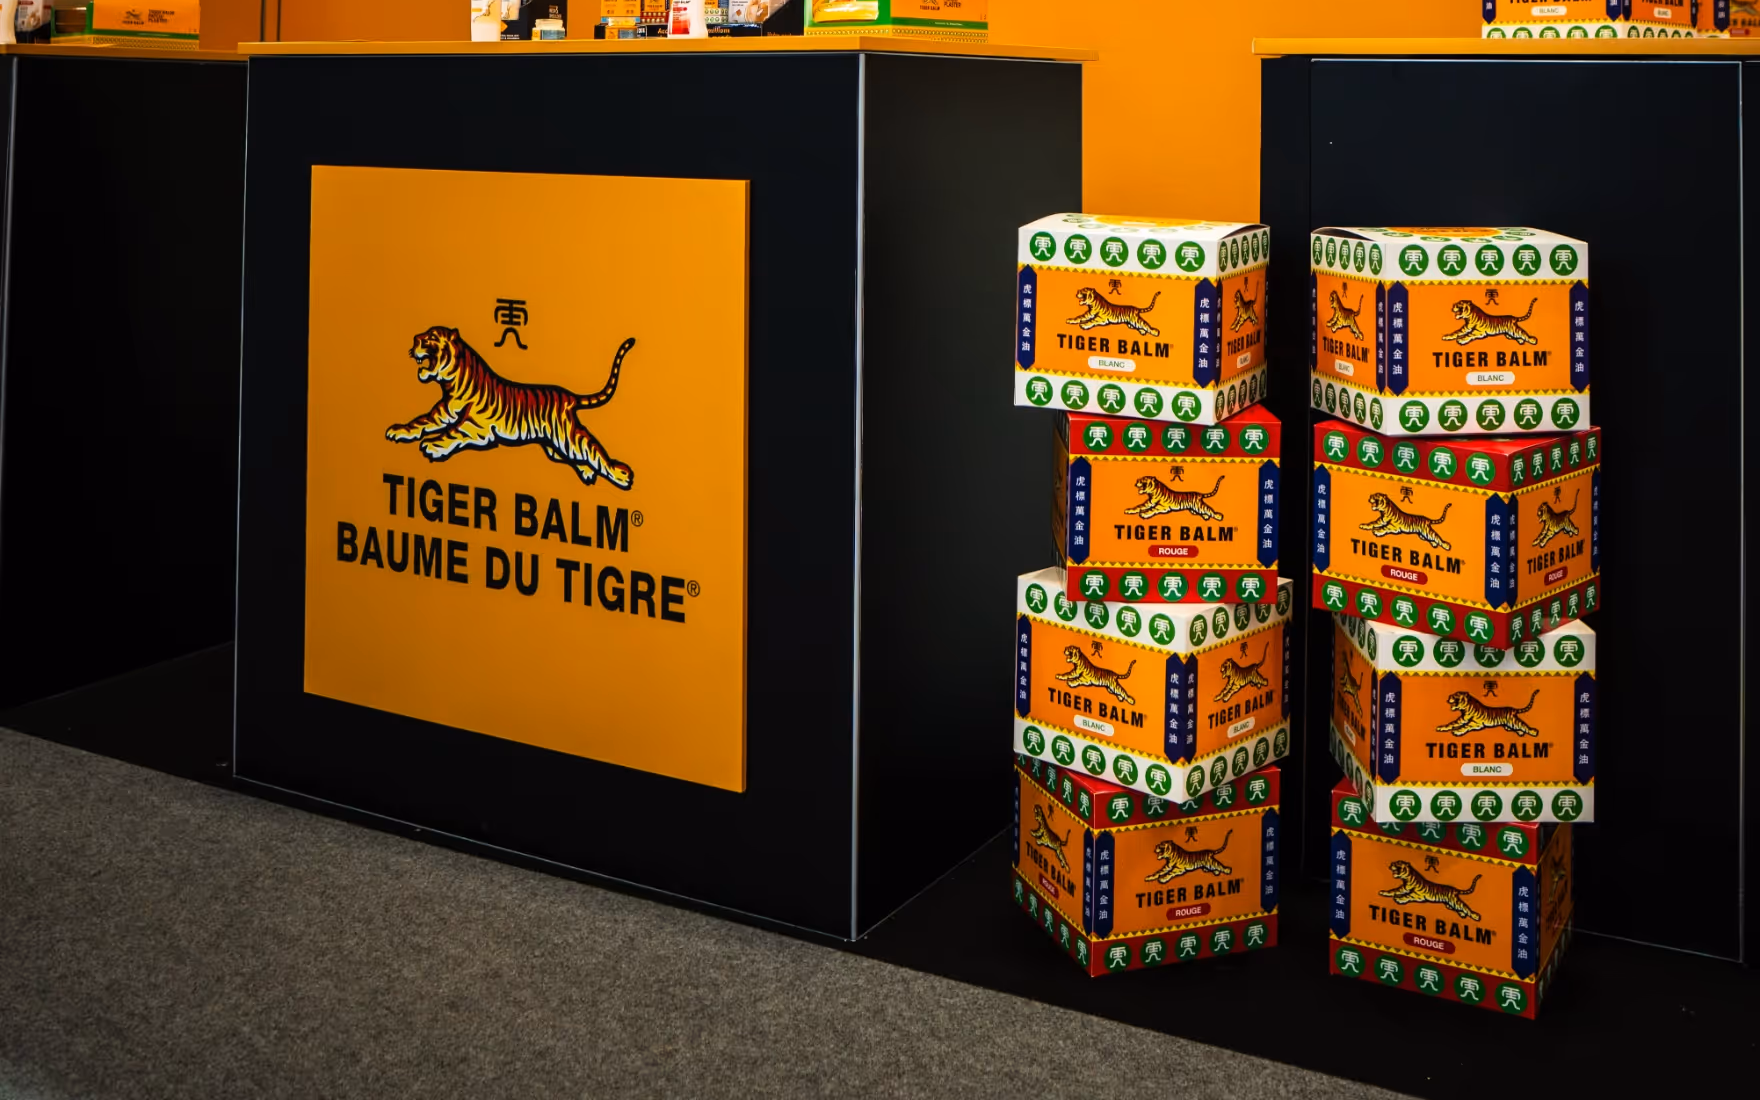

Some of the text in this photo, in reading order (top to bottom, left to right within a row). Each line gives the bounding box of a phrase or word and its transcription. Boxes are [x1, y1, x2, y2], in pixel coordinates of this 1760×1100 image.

[1057, 333, 1170, 358] TIGER BALM
[1227, 330, 1261, 356] TIGER BALM
[1322, 336, 1369, 363] TIGER BALM
[1098, 359, 1126, 368] BLANC
[1432, 350, 1548, 368] TIGER BALM
[1477, 374, 1505, 382] BLANC
[383, 473, 497, 532] TIGER
[1114, 524, 1234, 542] TIGER BALM
[337, 521, 469, 584] BAUME
[485, 546, 539, 596] DU
[1158, 547, 1189, 556] ROUGE
[1350, 537, 1462, 575] TIGER BALM
[1527, 540, 1585, 575] TIGER BALM
[1390, 568, 1419, 582] ROUGE
[1548, 569, 1564, 582] ROUGE
[1047, 687, 1144, 728] TIGER BALM
[1207, 690, 1275, 730] TIGER BALM
[1082, 719, 1106, 732] BLANC
[1233, 722, 1250, 734] BLANC
[1426, 742, 1550, 759] TIGER BALM
[1472, 765, 1502, 773] BLANC
[1026, 841, 1077, 898] TIGER BALM
[1136, 879, 1242, 908] TIGER BALM
[1175, 906, 1202, 918] ROUGE
[1368, 904, 1493, 946] TIGER BALM
[1414, 936, 1445, 950] ROUGE
